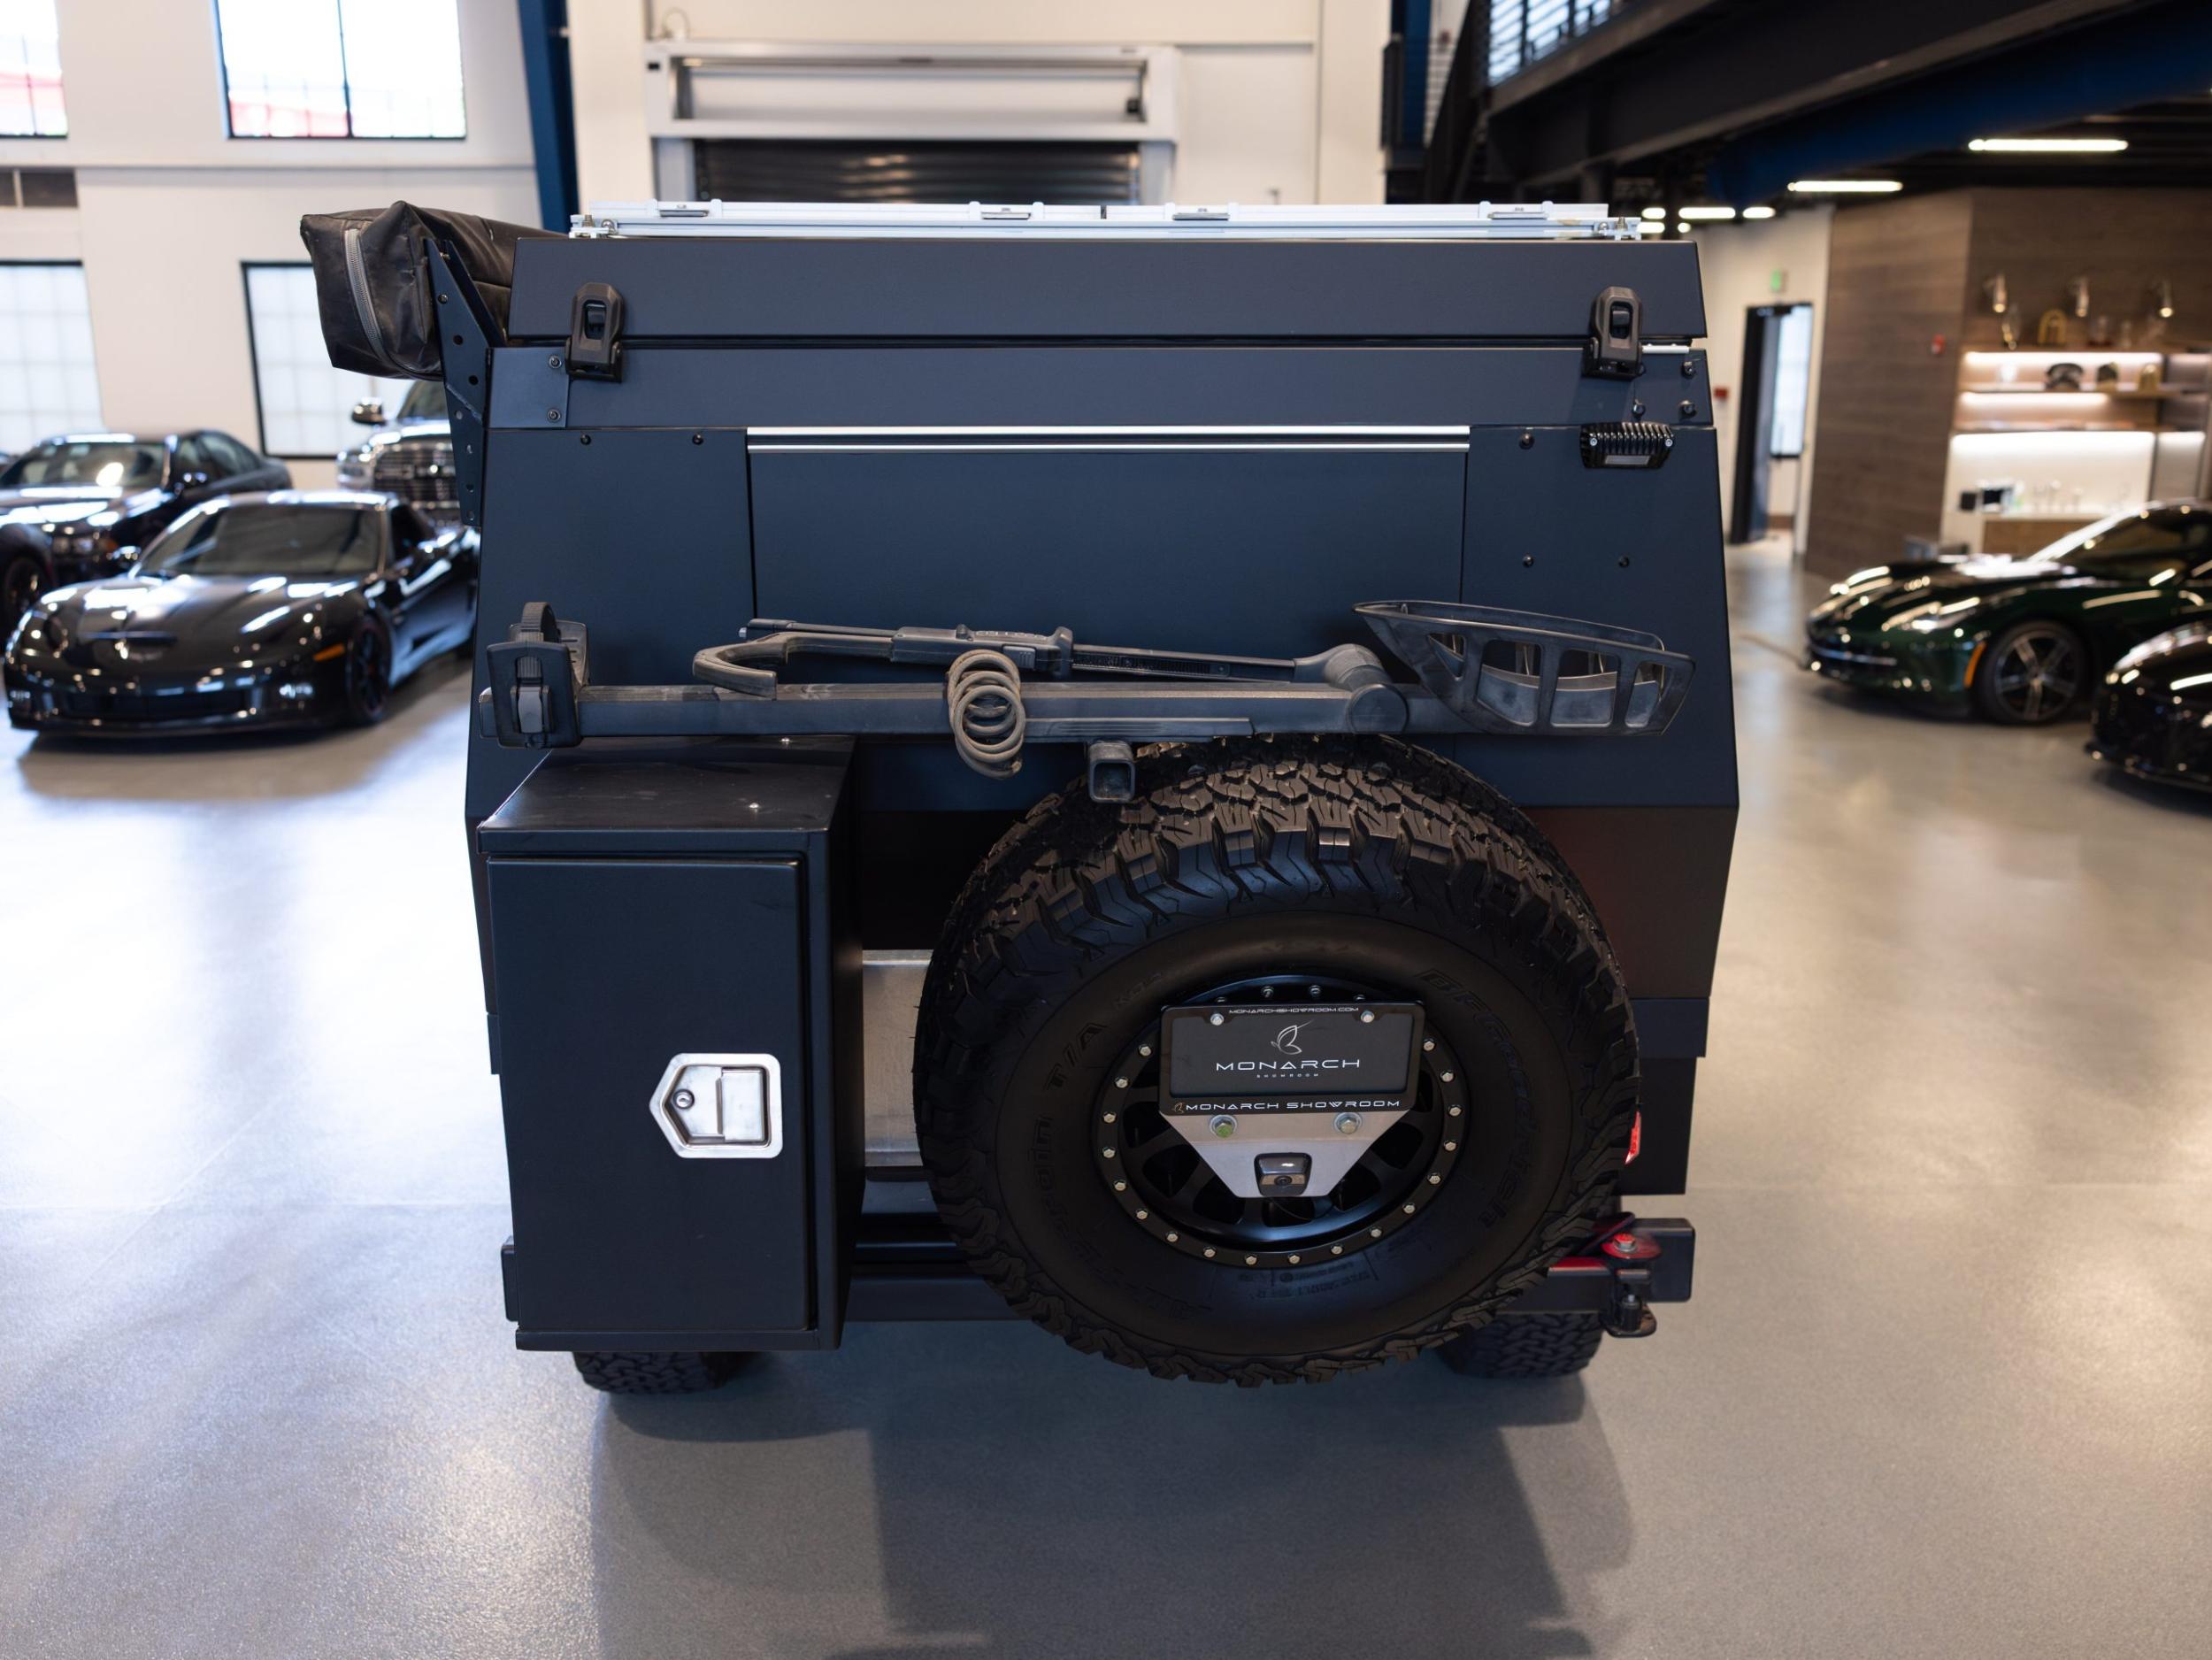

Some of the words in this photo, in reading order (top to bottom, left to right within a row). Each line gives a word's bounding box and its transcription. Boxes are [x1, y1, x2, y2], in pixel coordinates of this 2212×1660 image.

[1228, 1006, 1359, 1015] MONARCHSHOWROOM.COM
[1041, 1022, 1110, 1092] T/A
[1216, 1058, 1360, 1072] MONARCH
[1186, 1103, 1279, 1111] MONARCH
[1286, 1100, 1401, 1111] SHOWROOM
